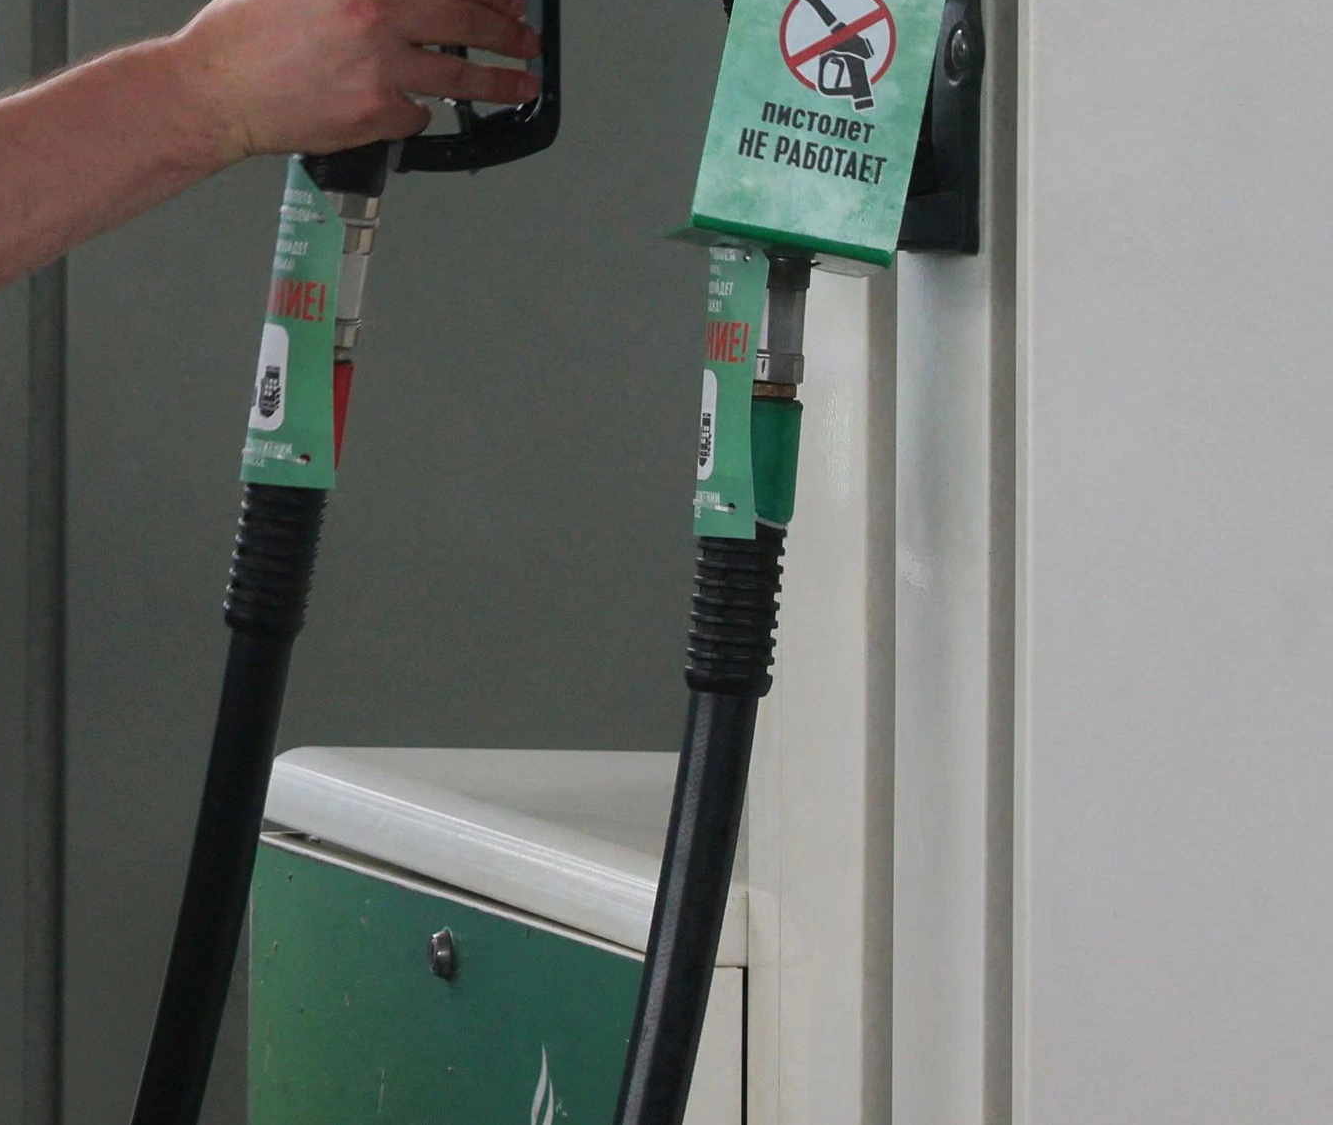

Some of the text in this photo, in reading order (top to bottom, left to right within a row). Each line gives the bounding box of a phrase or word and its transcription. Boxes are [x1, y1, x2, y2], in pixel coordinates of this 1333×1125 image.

[761, 101, 875, 143] пистолет
[738, 127, 887, 184] НЕ РАБОТАЕТ
